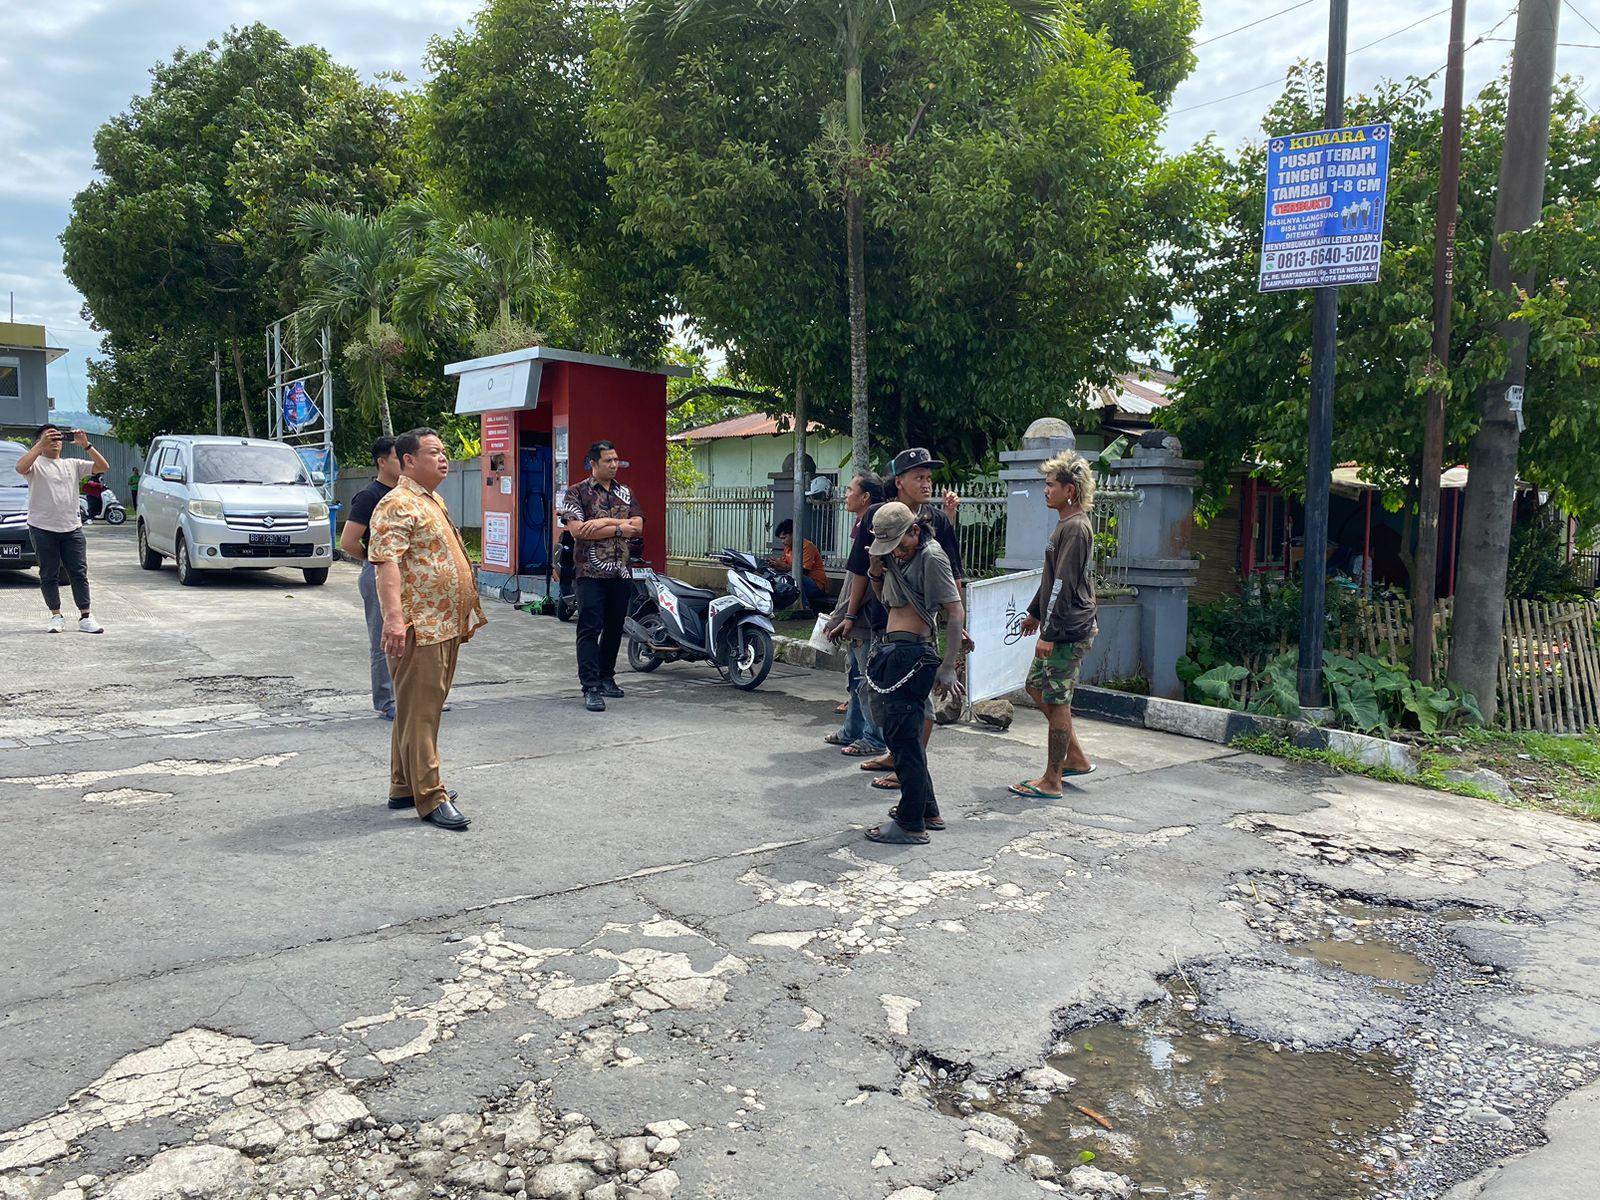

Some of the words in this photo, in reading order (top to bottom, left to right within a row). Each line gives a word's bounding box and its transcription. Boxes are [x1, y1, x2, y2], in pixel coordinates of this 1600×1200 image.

[1290, 130, 1366, 150] KUMARA
[1279, 151, 1323, 169] PUSAT
[1326, 146, 1376, 162] TERAPI
[1278, 166, 1324, 185] TINGGI
[1327, 162, 1376, 178] BADAN
[1272, 181, 1327, 201] TAMBAH
[1331, 179, 1353, 193] 1-8
[1356, 178, 1381, 192] CM
[1274, 197, 1331, 214] TERBUKTI
[1267, 217, 1300, 226] HASILNYA
[1302, 211, 1339, 223] LANGSUNG
[1280, 225, 1296, 233] BISA
[1298, 221, 1323, 230] DILIHAT
[1265, 240, 1315, 251] MENYEMBUHKAN
[1332, 236, 1351, 244] LETER
[1358, 234, 1373, 242] DAN
[1285, 230, 1318, 239] DITEMPAT
[1277, 244, 1378, 269] 0813-6640-5020
[1346, 265, 1369, 273] NEGARA
[1265, 279, 1294, 287] KAMPUNG
[1320, 274, 1337, 282] KOTA
[3, 546, 18, 554] WKC
